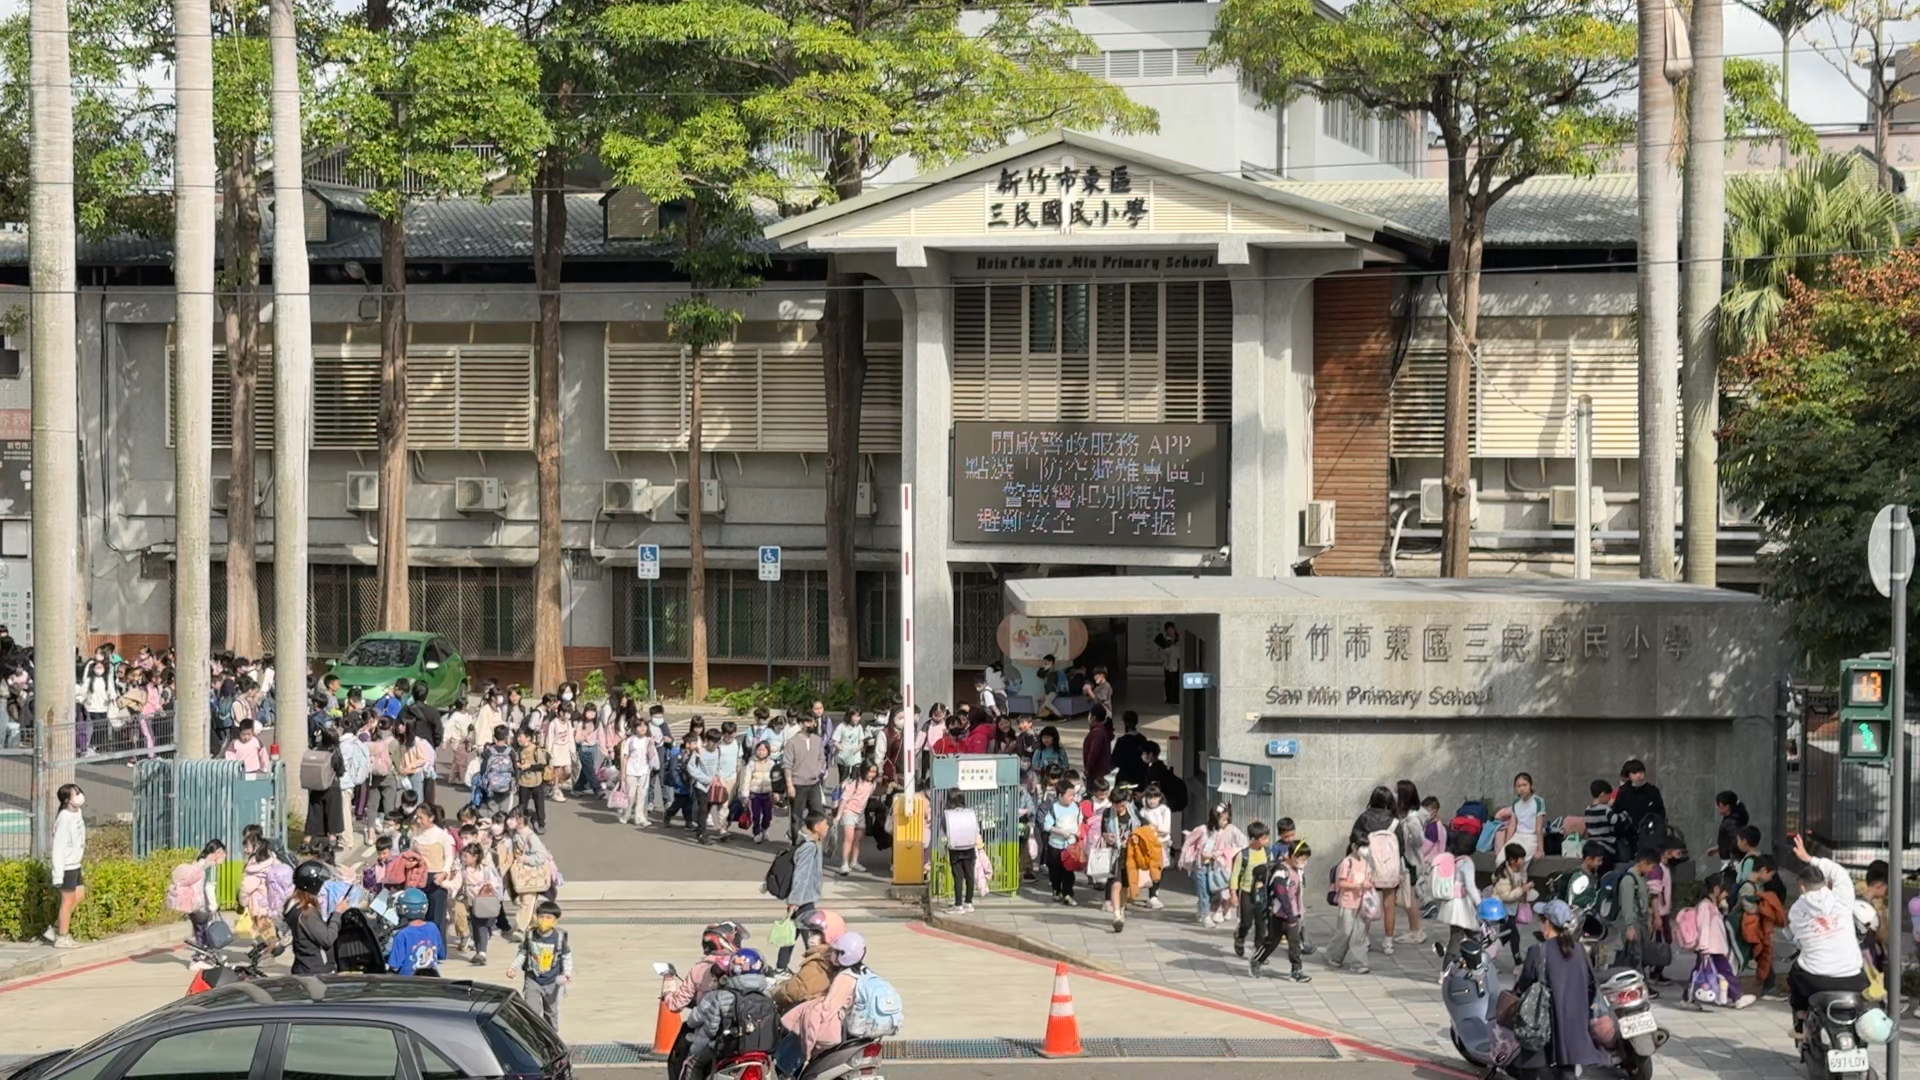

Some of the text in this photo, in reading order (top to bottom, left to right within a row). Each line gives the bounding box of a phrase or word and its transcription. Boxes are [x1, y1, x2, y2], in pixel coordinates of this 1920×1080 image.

[997, 165, 1132, 197] 新竹市東區
[988, 197, 1149, 228] 三民國民小學
[1011, 256, 1035, 269] Chu
[1039, 257, 1062, 270] San
[1067, 255, 1096, 269] Min
[1102, 256, 1160, 270] Primary
[1165, 255, 1213, 269] School
[1148, 435, 1192, 454] APP
[1266, 623, 1692, 663] 新竹市東區三民國民小學
[1266, 686, 1492, 710] San Min Primary School
